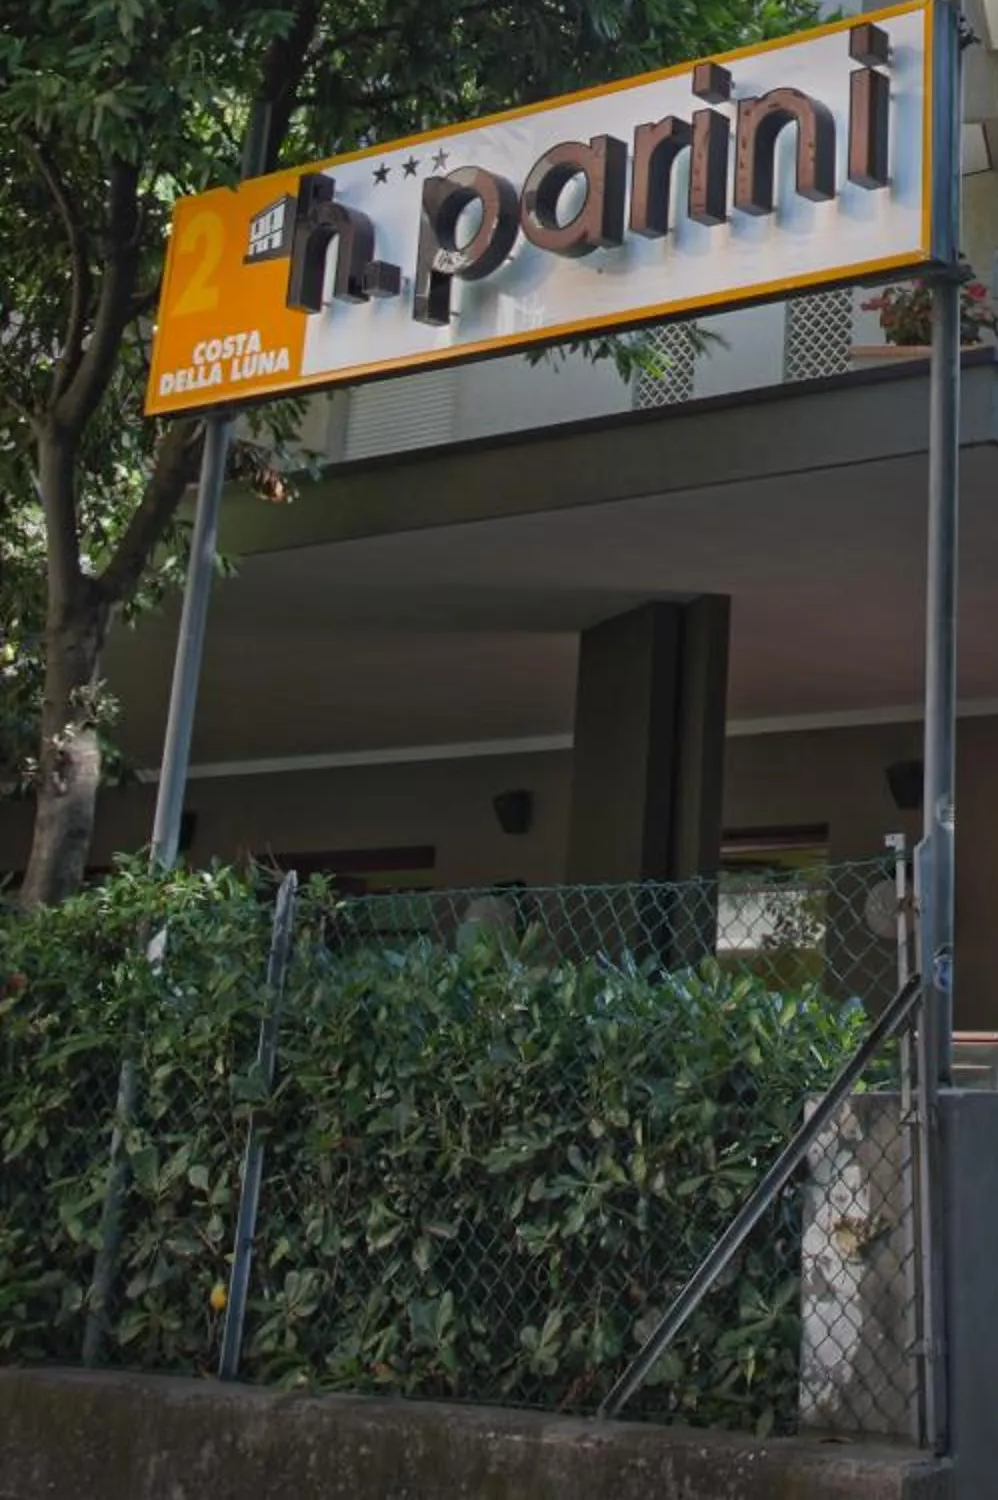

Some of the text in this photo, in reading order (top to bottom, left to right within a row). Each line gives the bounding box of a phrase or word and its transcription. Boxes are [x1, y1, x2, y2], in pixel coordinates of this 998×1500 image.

[412, 21, 891, 327] parini
[172, 210, 224, 318] 2
[159, 348, 290, 396] DELLA LUNA
[193, 330, 261, 365] COSTA
